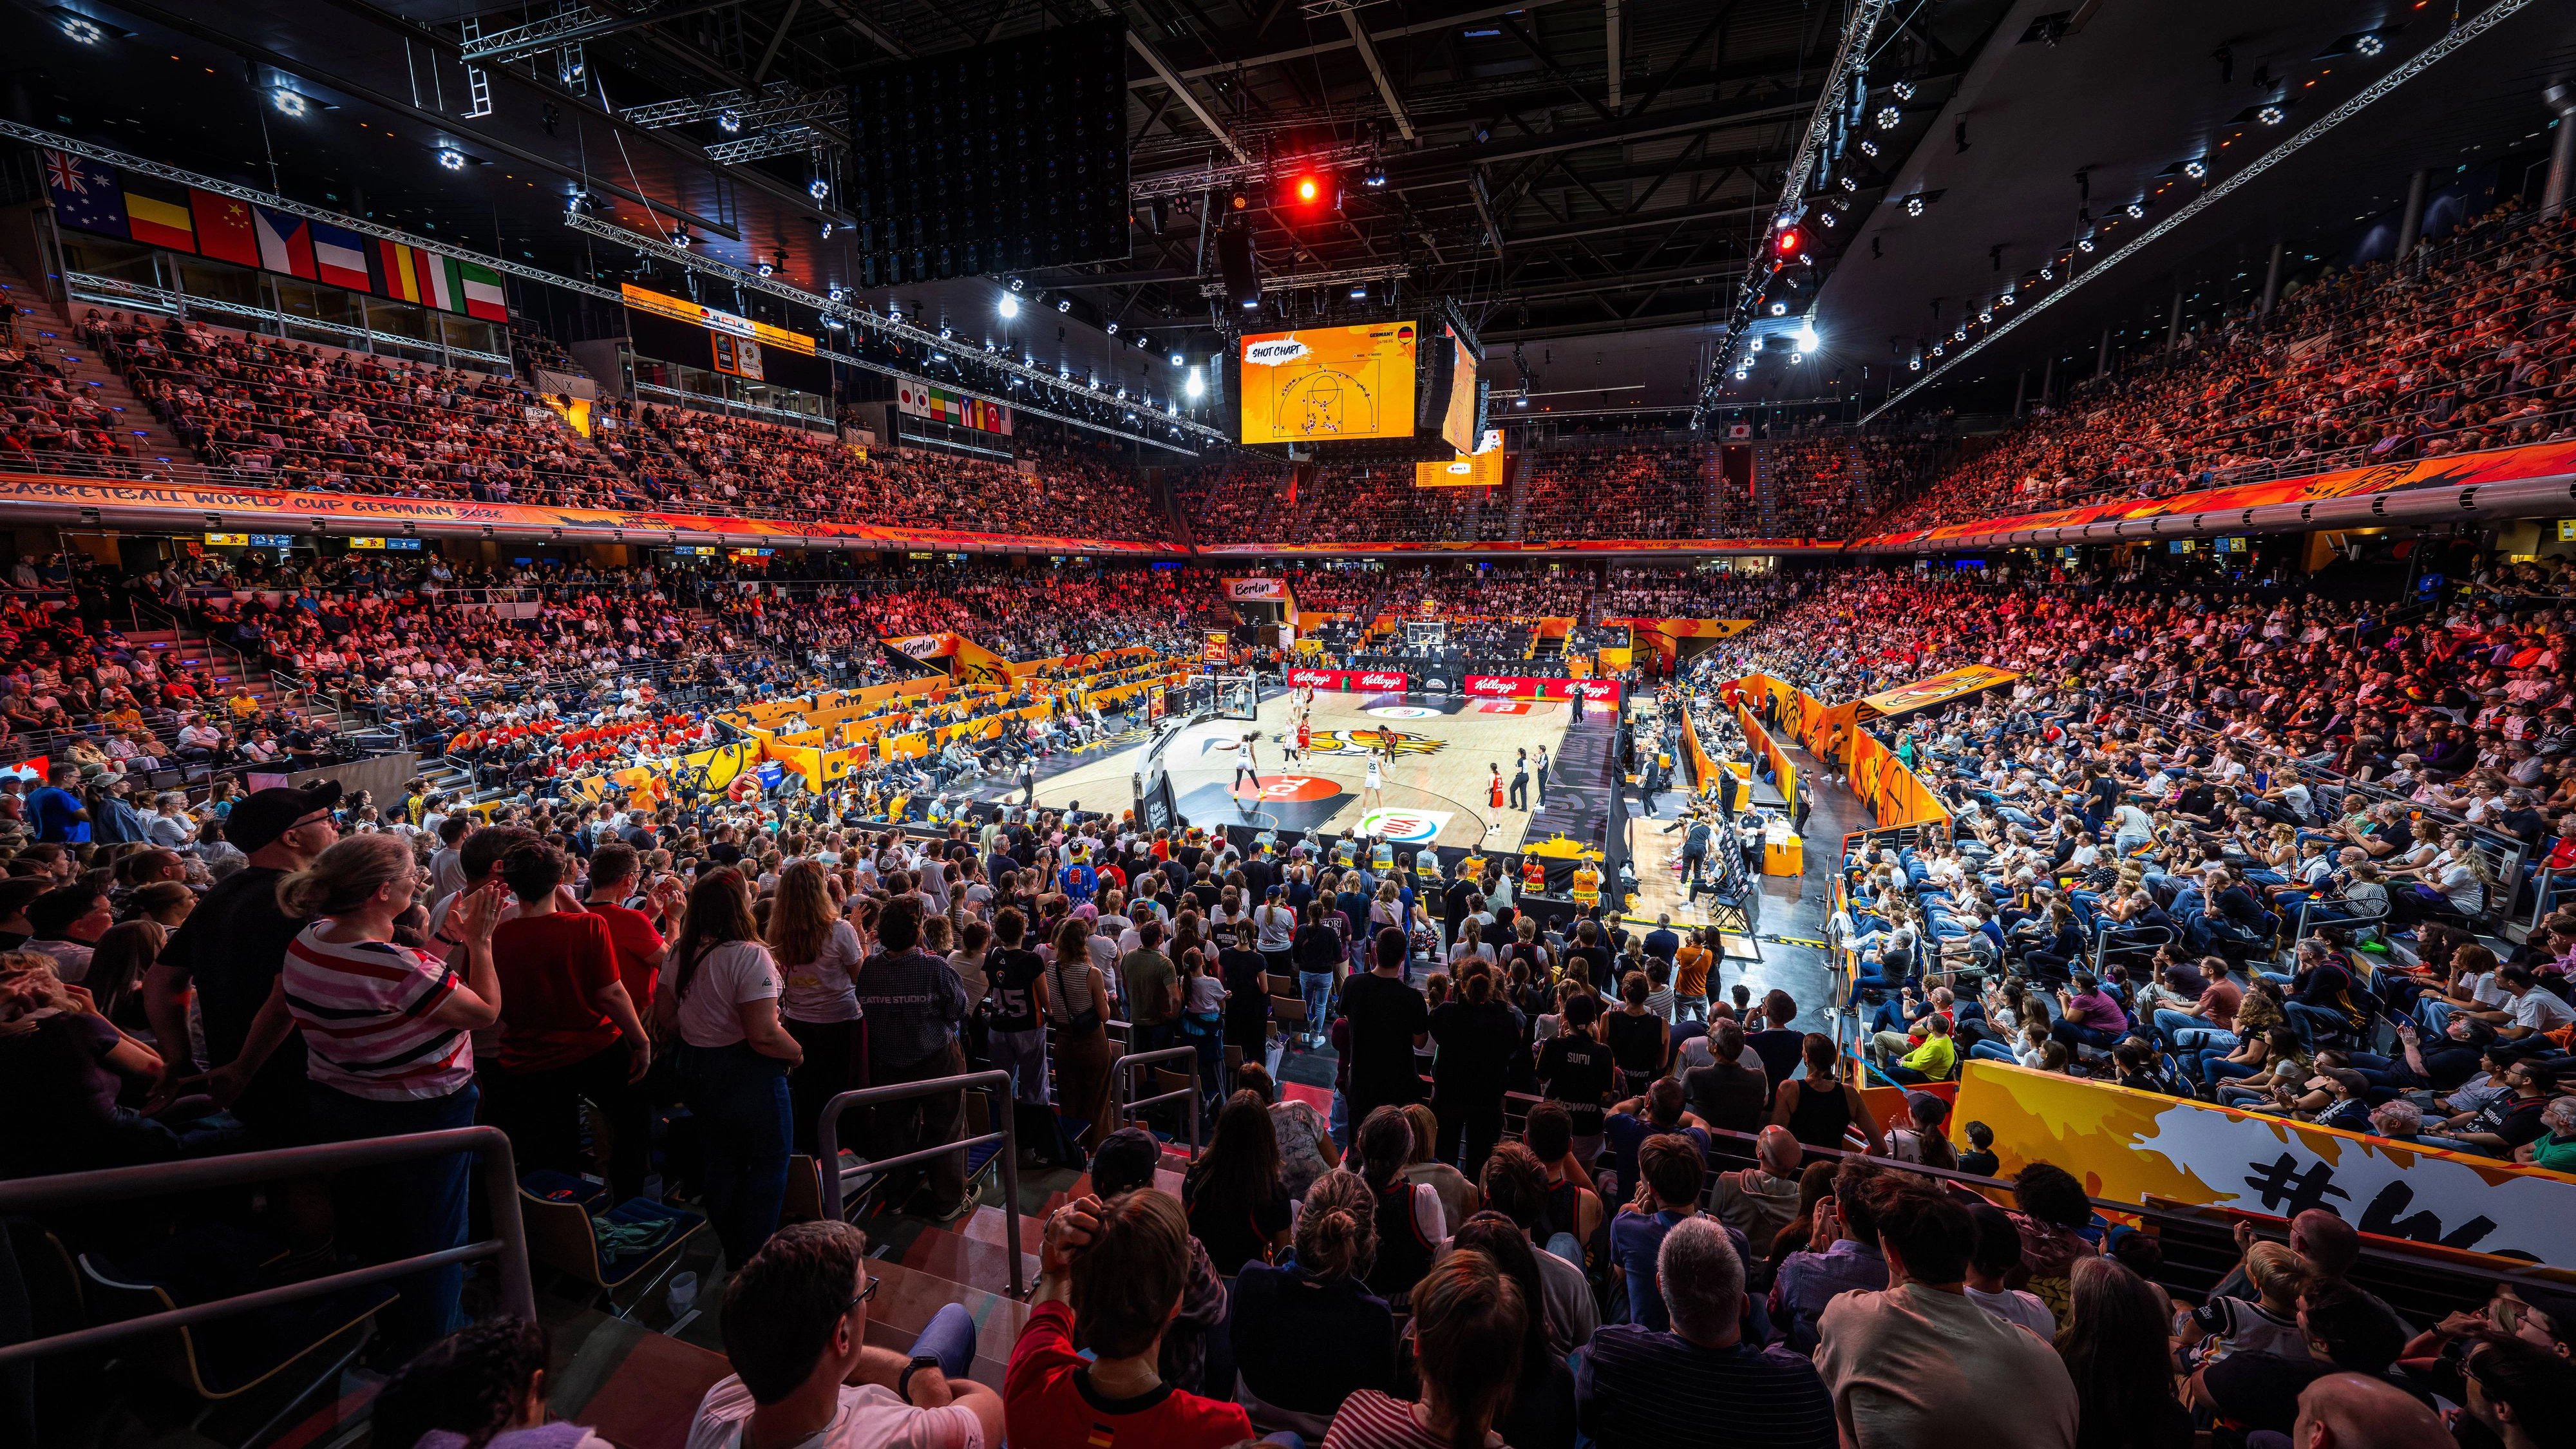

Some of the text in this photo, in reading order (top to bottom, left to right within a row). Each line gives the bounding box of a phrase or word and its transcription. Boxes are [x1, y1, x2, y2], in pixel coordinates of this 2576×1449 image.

[1253, 345, 1302, 357] SHOT CHART
[565, 381, 573, 390] X
[194, 489, 283, 507] WORLD
[294, 498, 345, 509] CUP
[351, 501, 453, 516] GERMANY
[457, 507, 504, 518] 2026
[1235, 582, 1269, 595] Berlin
[1209, 634, 1226, 643] 4:29
[904, 639, 936, 656] Berlin
[1293, 671, 1331, 685] Kellogg's
[1362, 674, 1401, 688] Kellogg's
[1475, 678, 1518, 694] Kellogg's
[1152, 701, 1164, 716] 24
[1256, 778, 1311, 799] TCL
[1150, 800, 1162, 813] #We
[1153, 813, 1168, 830] Game!
[1567, 1052, 1591, 1066] SUMI
